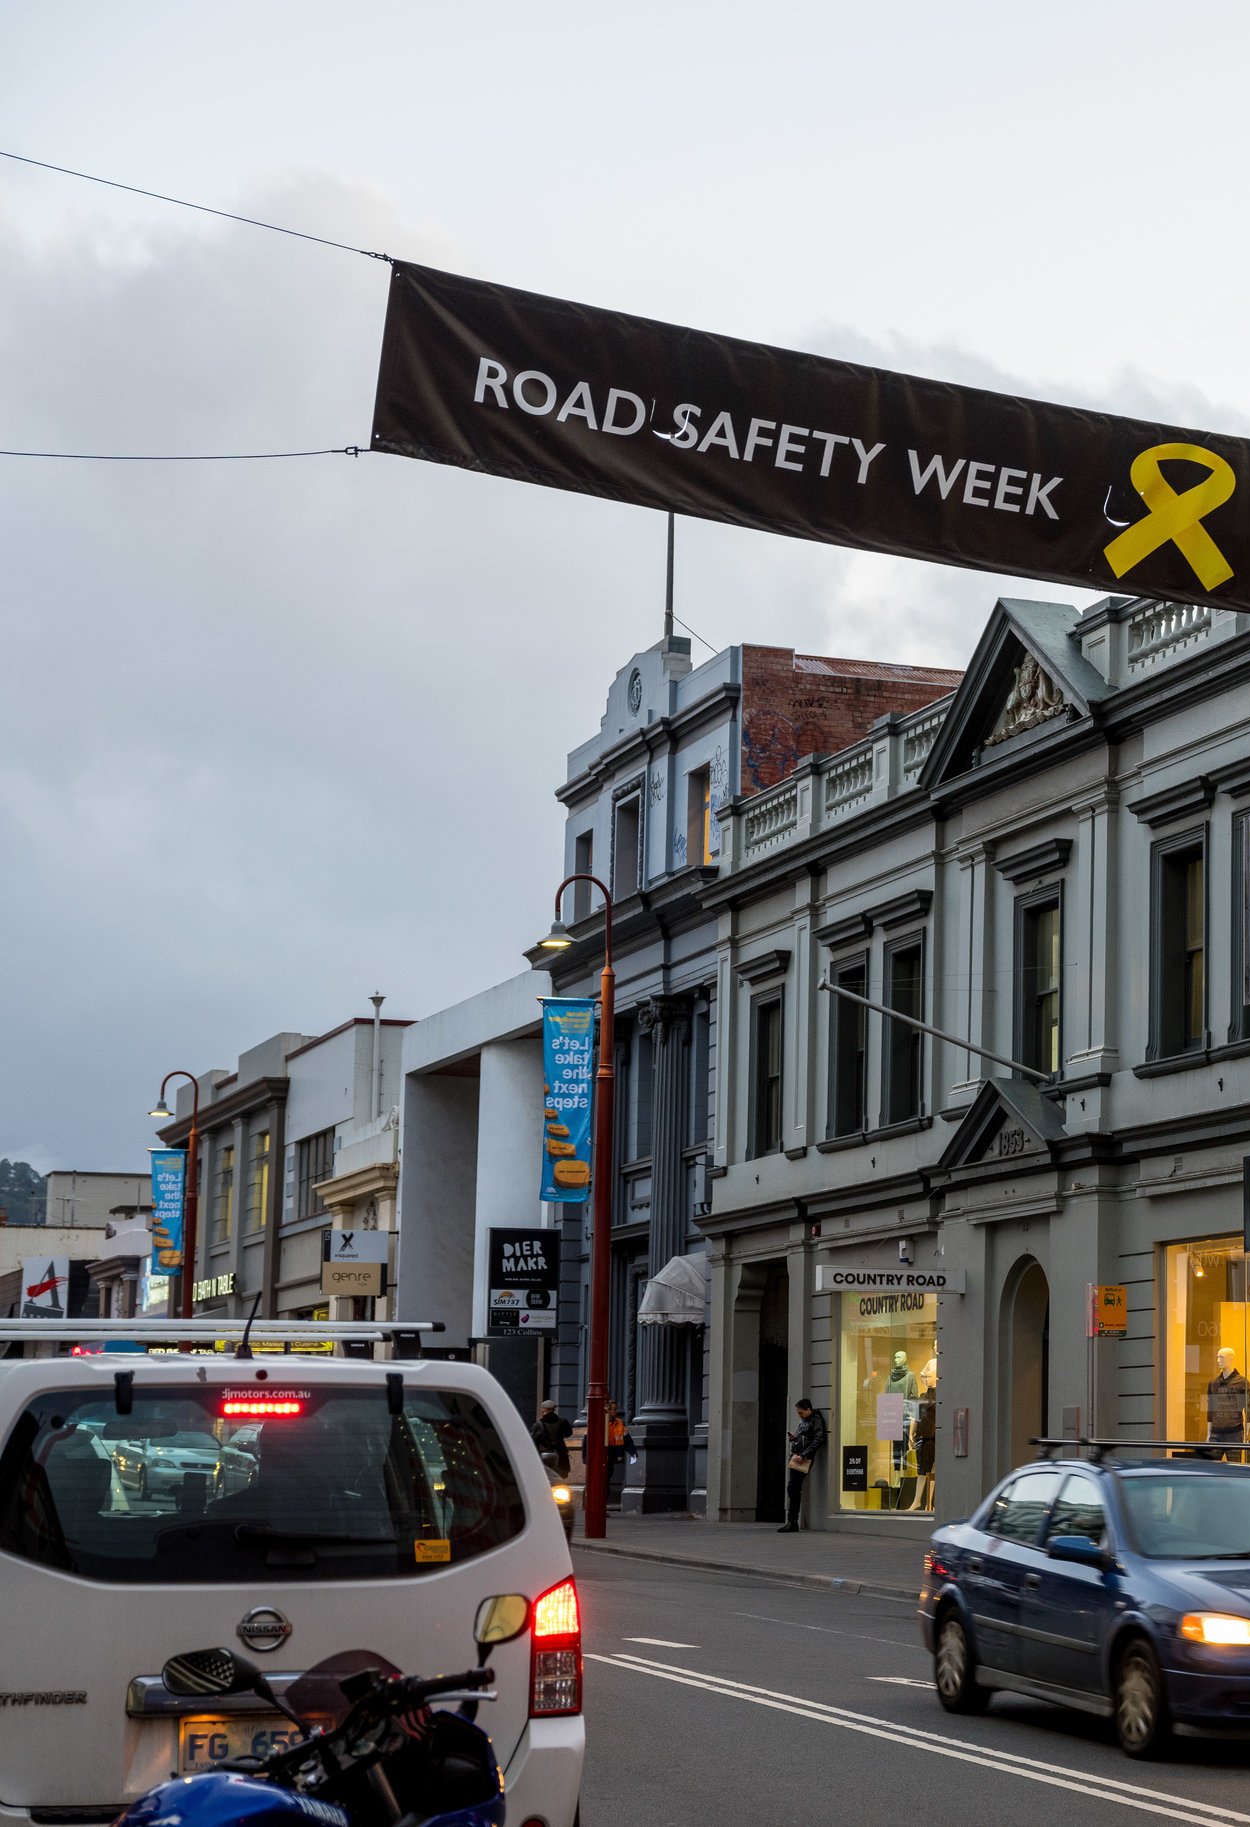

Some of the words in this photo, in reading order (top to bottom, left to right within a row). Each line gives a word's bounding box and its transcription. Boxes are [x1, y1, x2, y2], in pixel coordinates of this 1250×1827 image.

[474, 356, 647, 437] ROAD
[670, 402, 886, 485] SAFETY
[907, 449, 1063, 520] WEEK
[503, 1241, 543, 1257] DIER
[502, 1256, 548, 1272] MAKR
[332, 1272, 371, 1283] genre
[833, 1272, 903, 1287] COUNTRY
[907, 1275, 946, 1287] ROAD
[860, 1294, 899, 1316] COUNTRY
[900, 1293, 924, 1312] ROAD
[243, 1625, 287, 1633] NISSAN
[0, 1690, 87, 1707] THFINDER
[189, 1733, 228, 1760] FG
